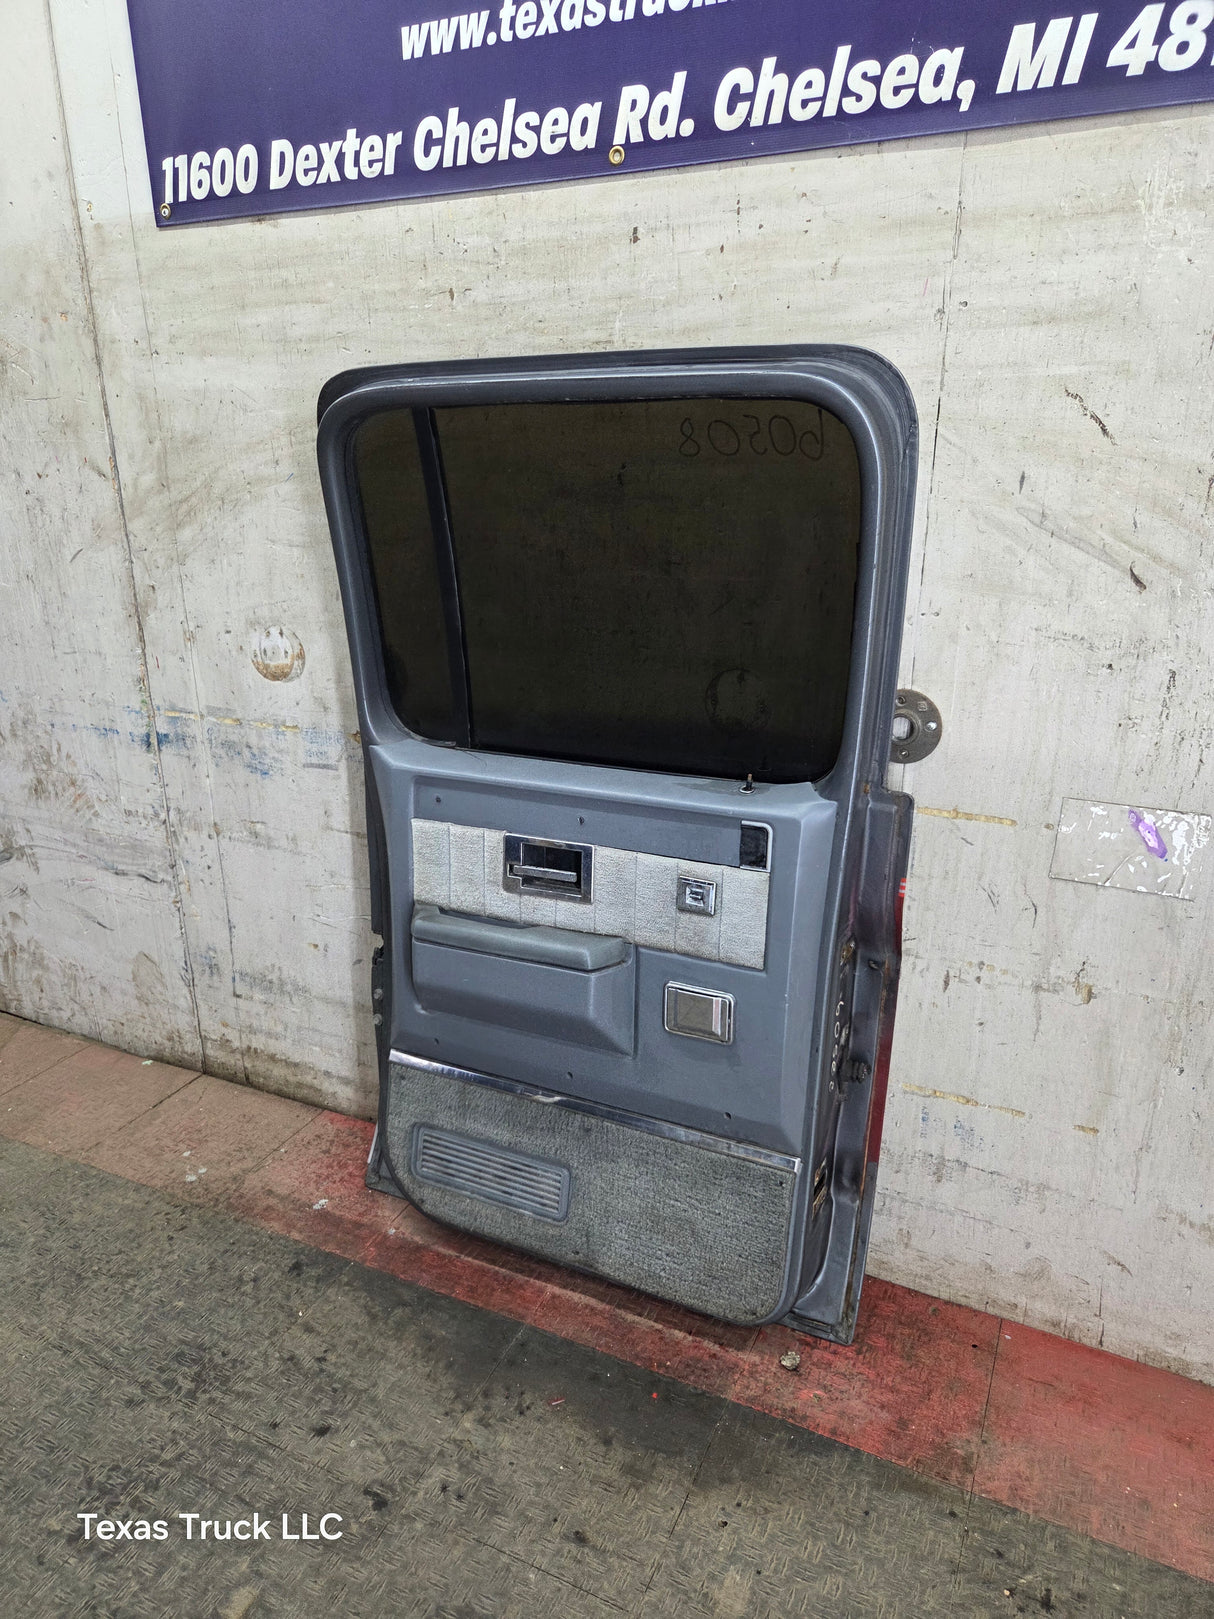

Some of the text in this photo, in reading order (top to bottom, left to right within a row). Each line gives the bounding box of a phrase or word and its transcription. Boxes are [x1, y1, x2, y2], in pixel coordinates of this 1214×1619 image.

[161, 0, 1214, 209] 11600 Dexter Chelsea Rd. Chelsea, MI 48
